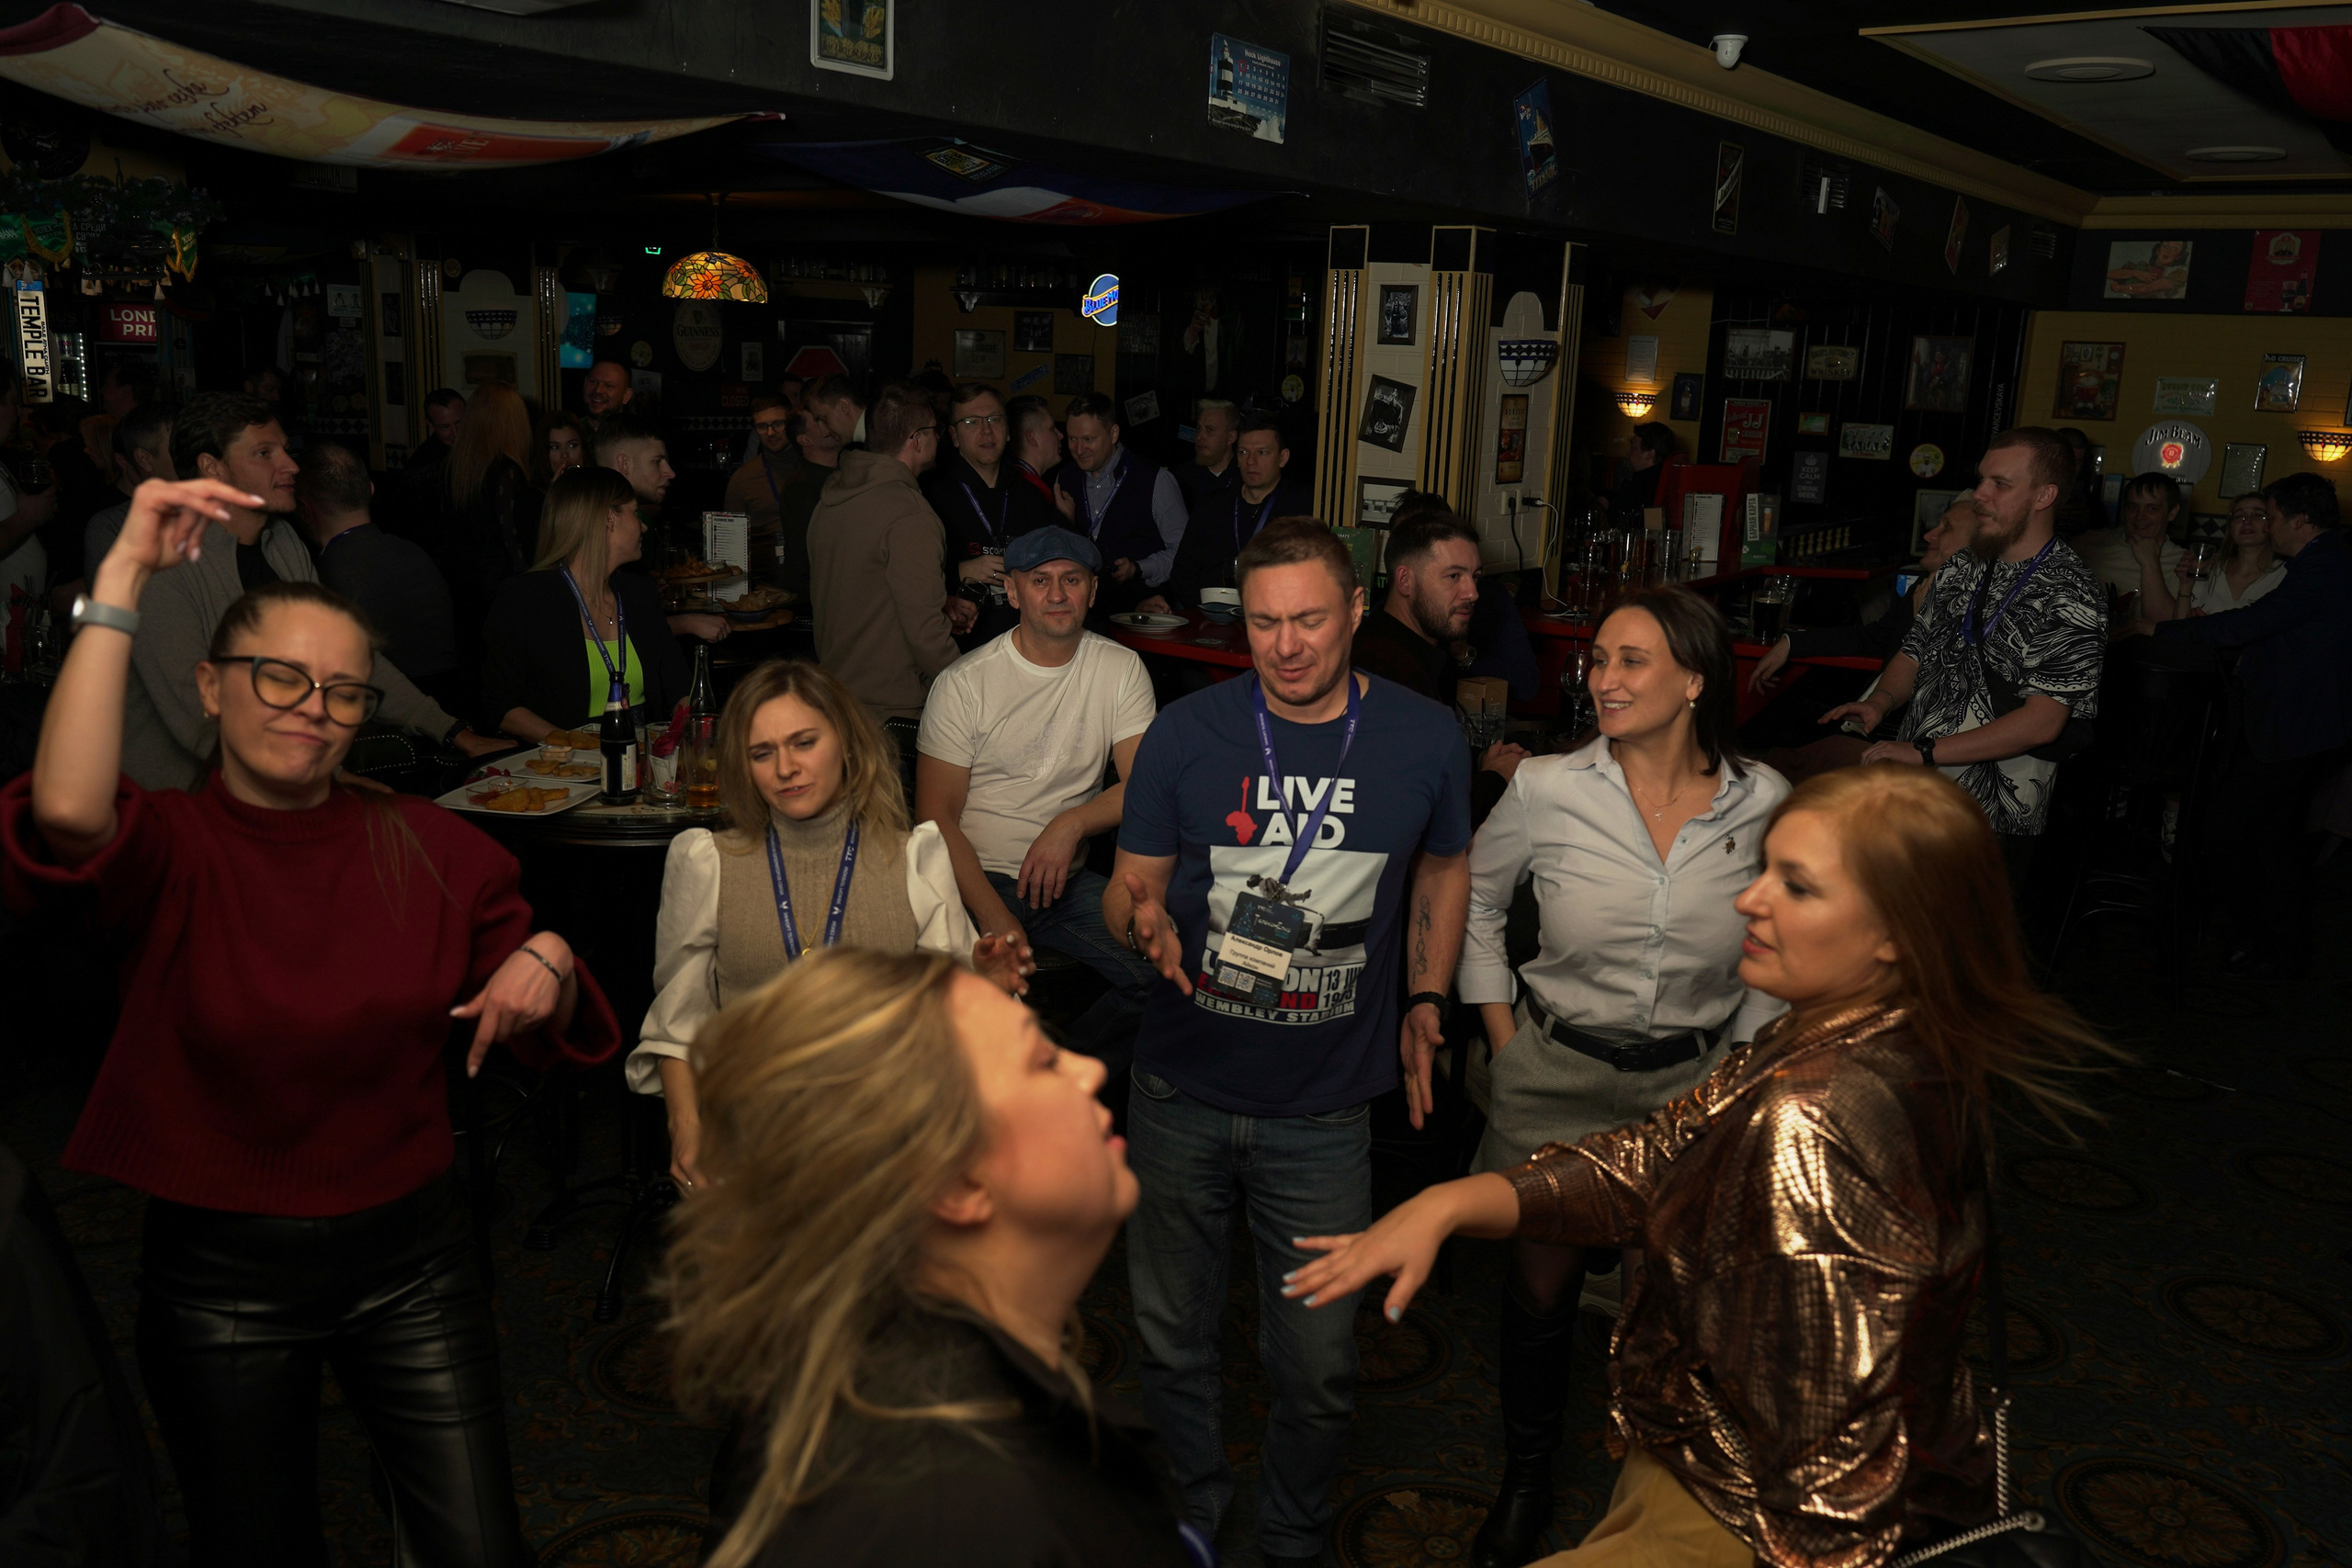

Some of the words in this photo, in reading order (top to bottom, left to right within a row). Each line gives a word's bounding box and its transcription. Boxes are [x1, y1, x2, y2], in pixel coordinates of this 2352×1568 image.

[1257, 53, 1281, 66] Lighthouse
[19, 296, 44, 364] TEMPLE
[122, 323, 157, 337] PRI
[677, 323, 719, 337] GUINNESS
[27, 366, 49, 398] BAR
[1811, 367, 1851, 377] WHISKEY
[1742, 412, 1764, 430] JJ
[2145, 428, 2168, 446] JIM
[2170, 425, 2202, 448] BEAM
[1799, 472, 1820, 480] CALM
[1797, 484, 1819, 492] DRINK
[1797, 491, 1817, 500] BEER.
[1748, 516, 1758, 539] БАРНАЯ
[1257, 775, 1356, 814] LIVE
[1259, 812, 1346, 850] AID
[844, 845, 854, 862] ТТС
[1230, 935, 1263, 951] Александр
[1263, 946, 1283, 957] Орлов
[1229, 949, 1249, 962] Группа
[1249, 955, 1276, 969] компаний
[1326, 969, 1340, 991] 13
[1195, 990, 1280, 1021] WEMBLEY
[1286, 1001, 1355, 1022] STADIUM
